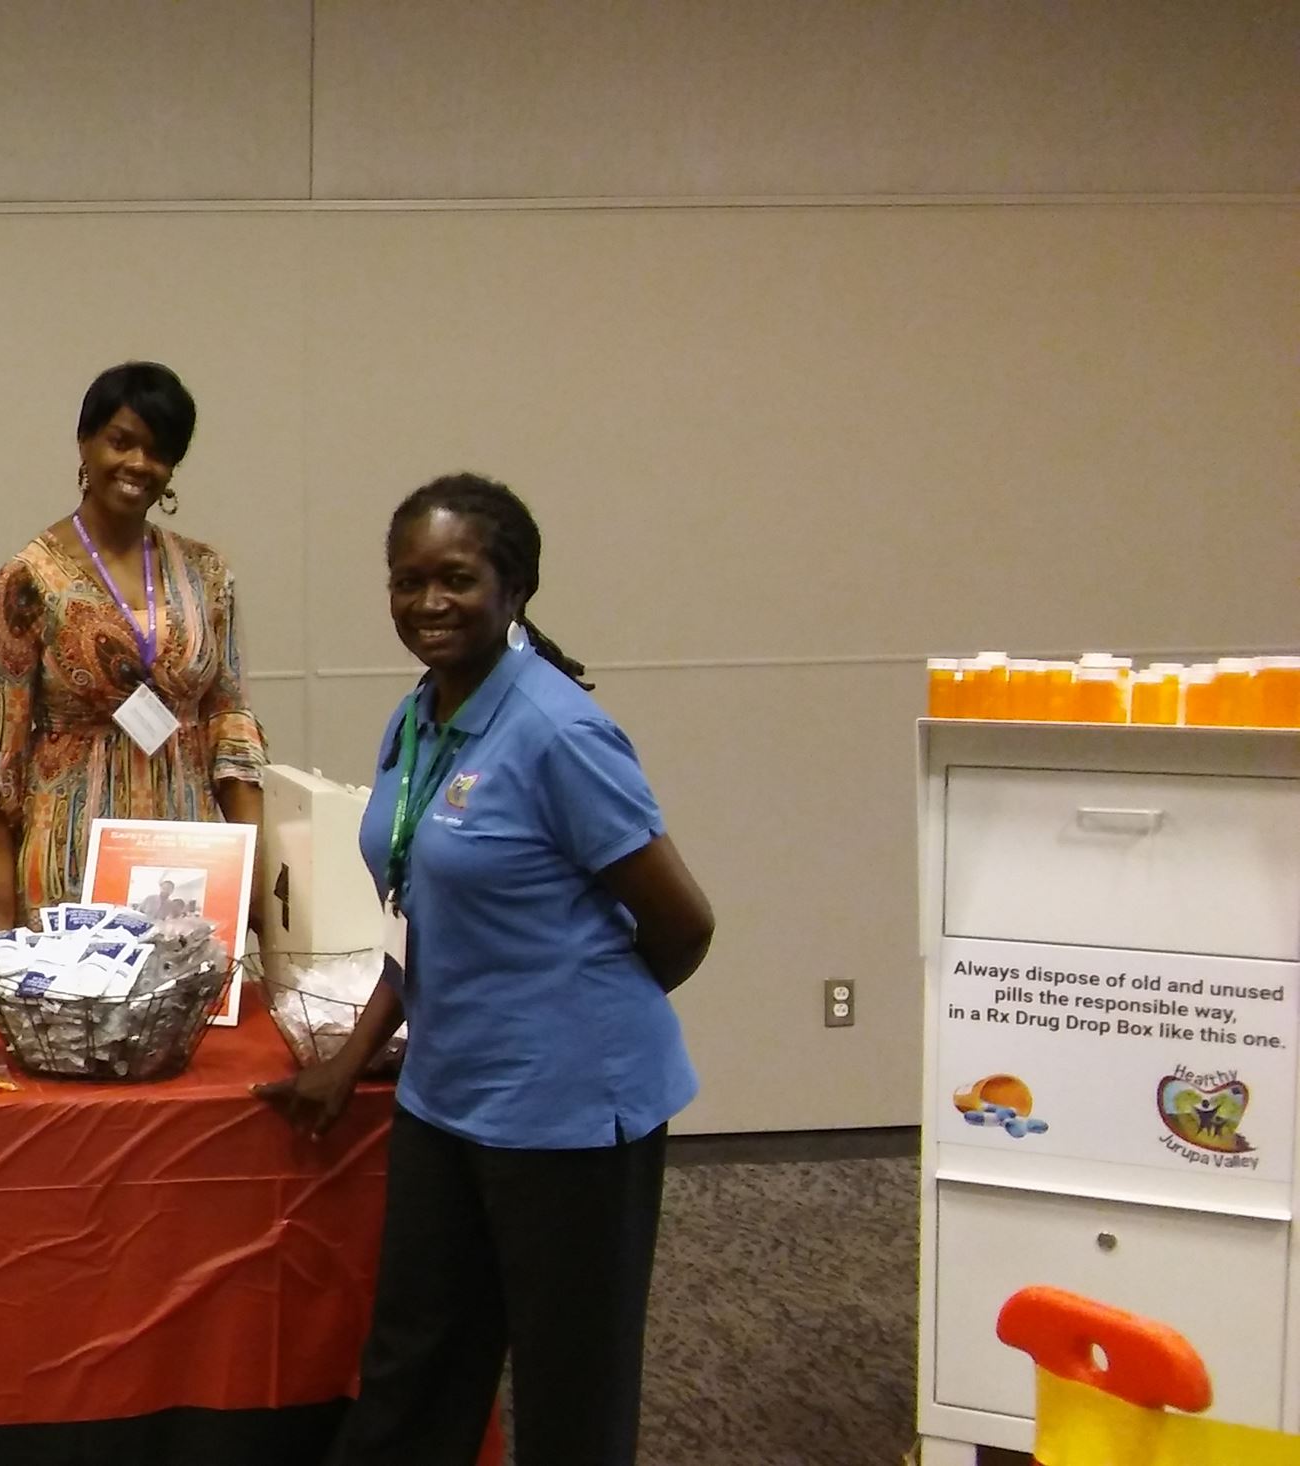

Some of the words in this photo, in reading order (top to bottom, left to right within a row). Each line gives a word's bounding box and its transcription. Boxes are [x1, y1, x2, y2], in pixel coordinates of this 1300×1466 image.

[954, 960, 1020, 982] Always
[1025, 966, 1100, 987] dispose
[1106, 973, 1127, 988] of
[1132, 975, 1161, 992] old
[1167, 979, 1203, 996] and
[1210, 985, 1285, 1002] unused
[994, 987, 1033, 1005] pills
[1039, 990, 1070, 1007] the
[1075, 994, 1188, 1018] responsible
[1194, 1005, 1238, 1024] way,
[948, 1004, 965, 1020] in
[970, 1009, 982, 1022] a
[986, 1008, 1010, 1024] Rx
[1015, 1011, 1060, 1032] Drug
[1066, 1015, 1111, 1035] Drop
[1117, 1019, 1153, 1037] Box
[1159, 1023, 1195, 1041] like
[1199, 1027, 1237, 1045] this
[1243, 1033, 1287, 1050] one.
[1173, 1063, 1239, 1087] Healthy
[1158, 1133, 1210, 1166] Jurupa
[1213, 1154, 1260, 1171] Valley
